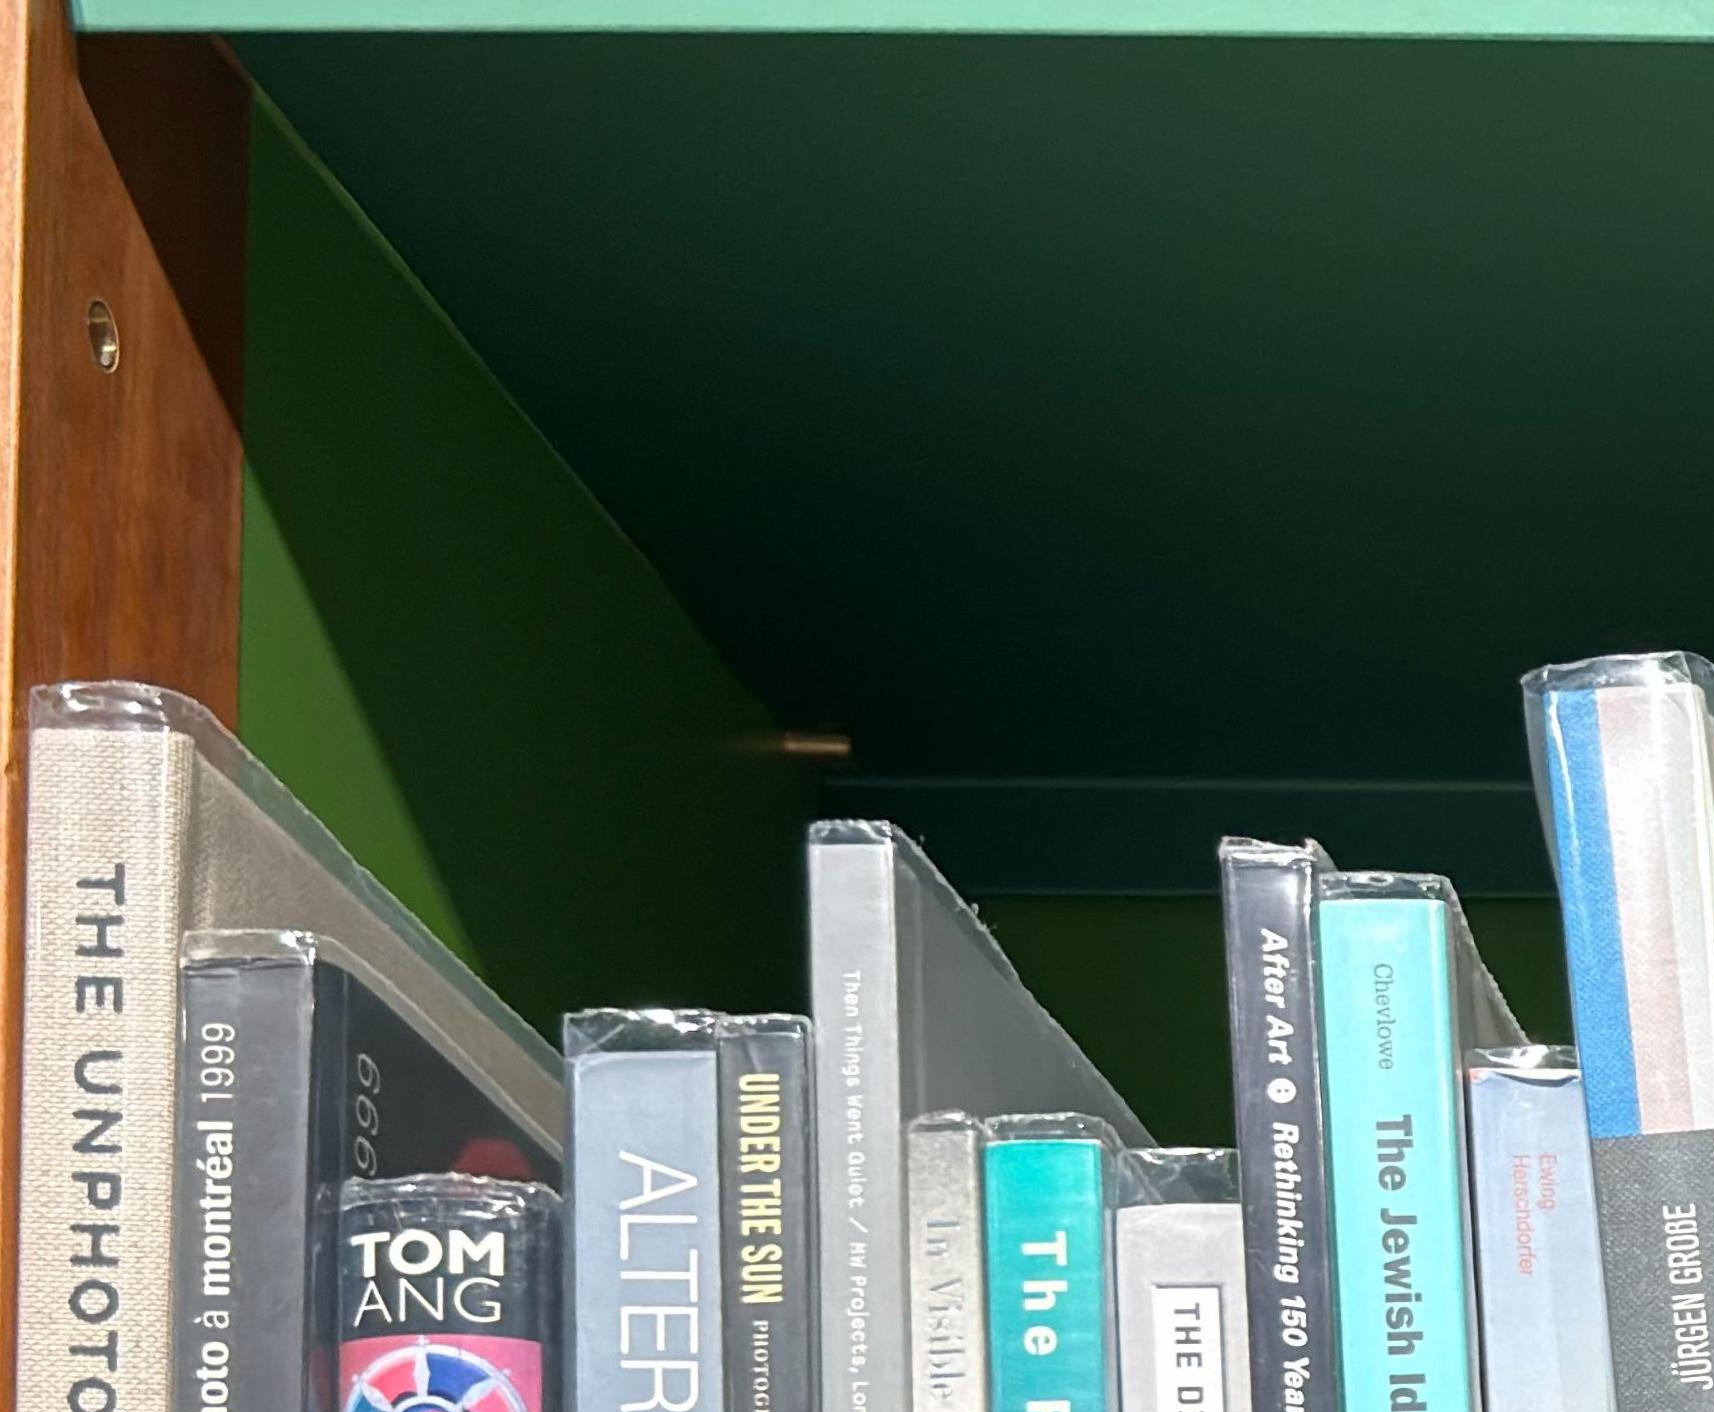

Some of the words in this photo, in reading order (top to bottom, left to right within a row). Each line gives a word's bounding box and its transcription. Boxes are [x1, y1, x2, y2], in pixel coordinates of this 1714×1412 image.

[76, 863, 125, 1014] THE
[1372, 962, 1394, 1071] Chevlowe
[738, 1073, 780, 1174] UNDER
[1375, 1113, 1411, 1193] The
[739, 1180, 782, 1237] THE
[1540, 1154, 1558, 1211] Ewing
[351, 1231, 505, 1276] TOM
[739, 1244, 785, 1304] SUN
[1020, 1231, 1068, 1357] The
[1379, 1208, 1423, 1356] Jewish
[354, 1280, 502, 1326] ANG
[1670, 1293, 1714, 1391] JÜRGEN
